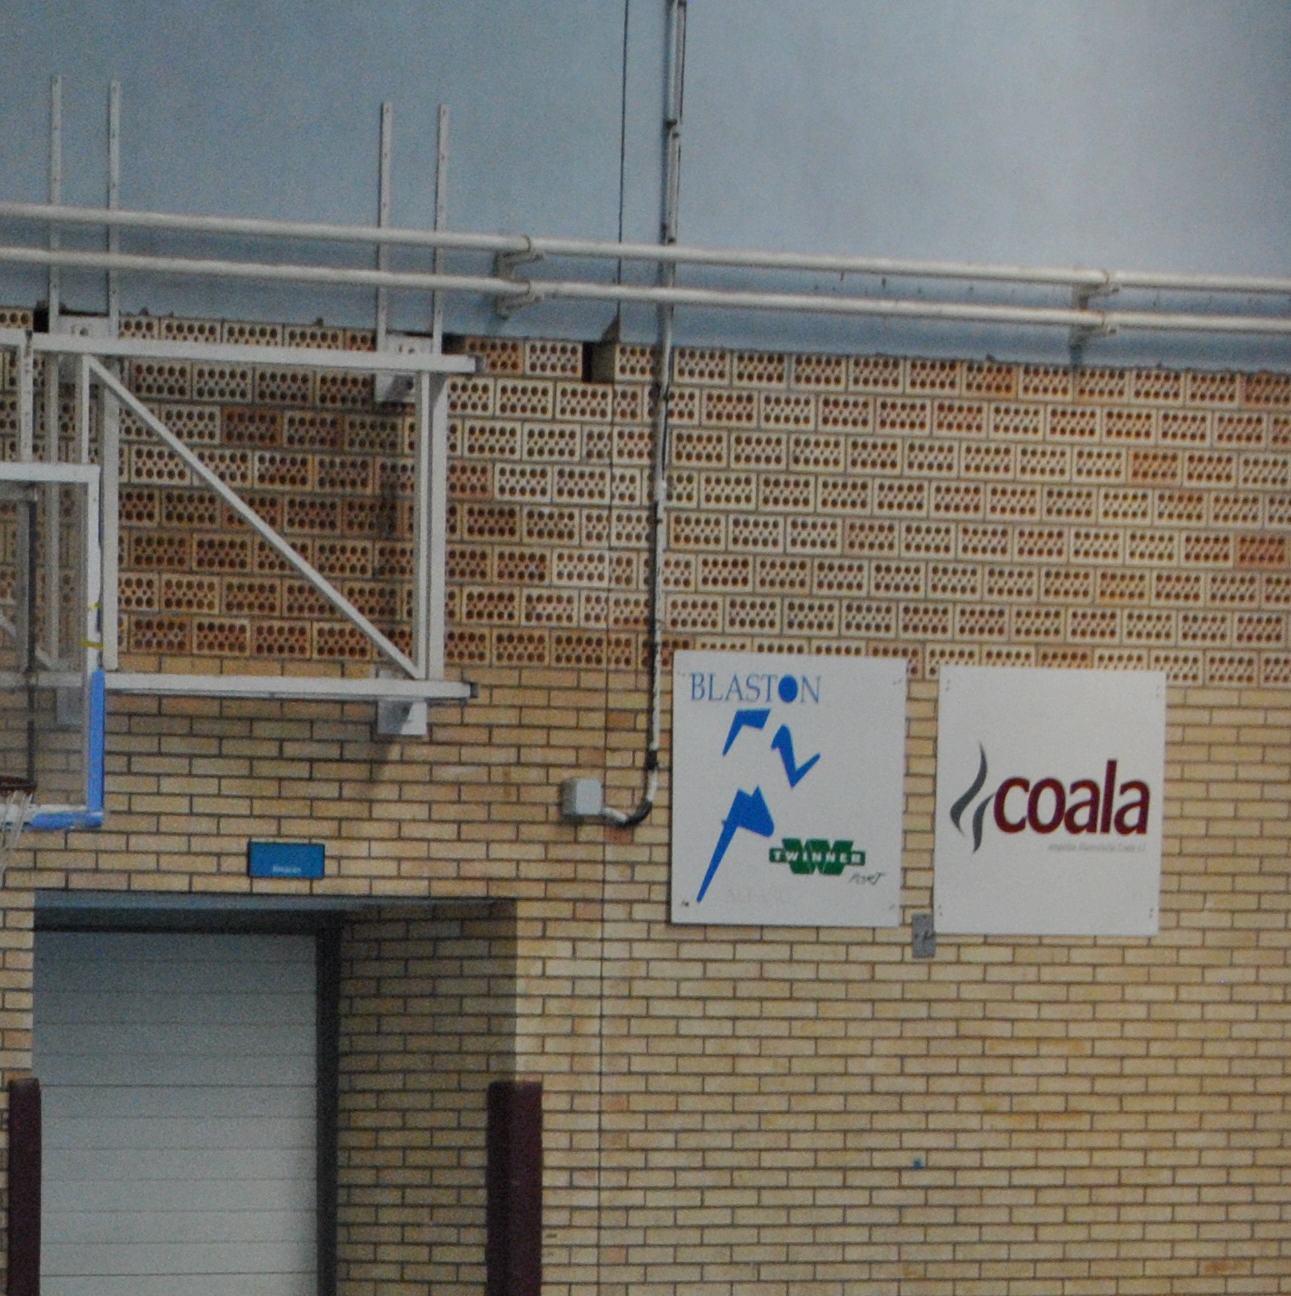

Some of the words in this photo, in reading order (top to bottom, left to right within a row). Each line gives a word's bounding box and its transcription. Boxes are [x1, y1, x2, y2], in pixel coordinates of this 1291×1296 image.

[690, 672, 822, 704] BLASTON
[993, 759, 1152, 836] coala
[773, 850, 862, 864] TWINNER
